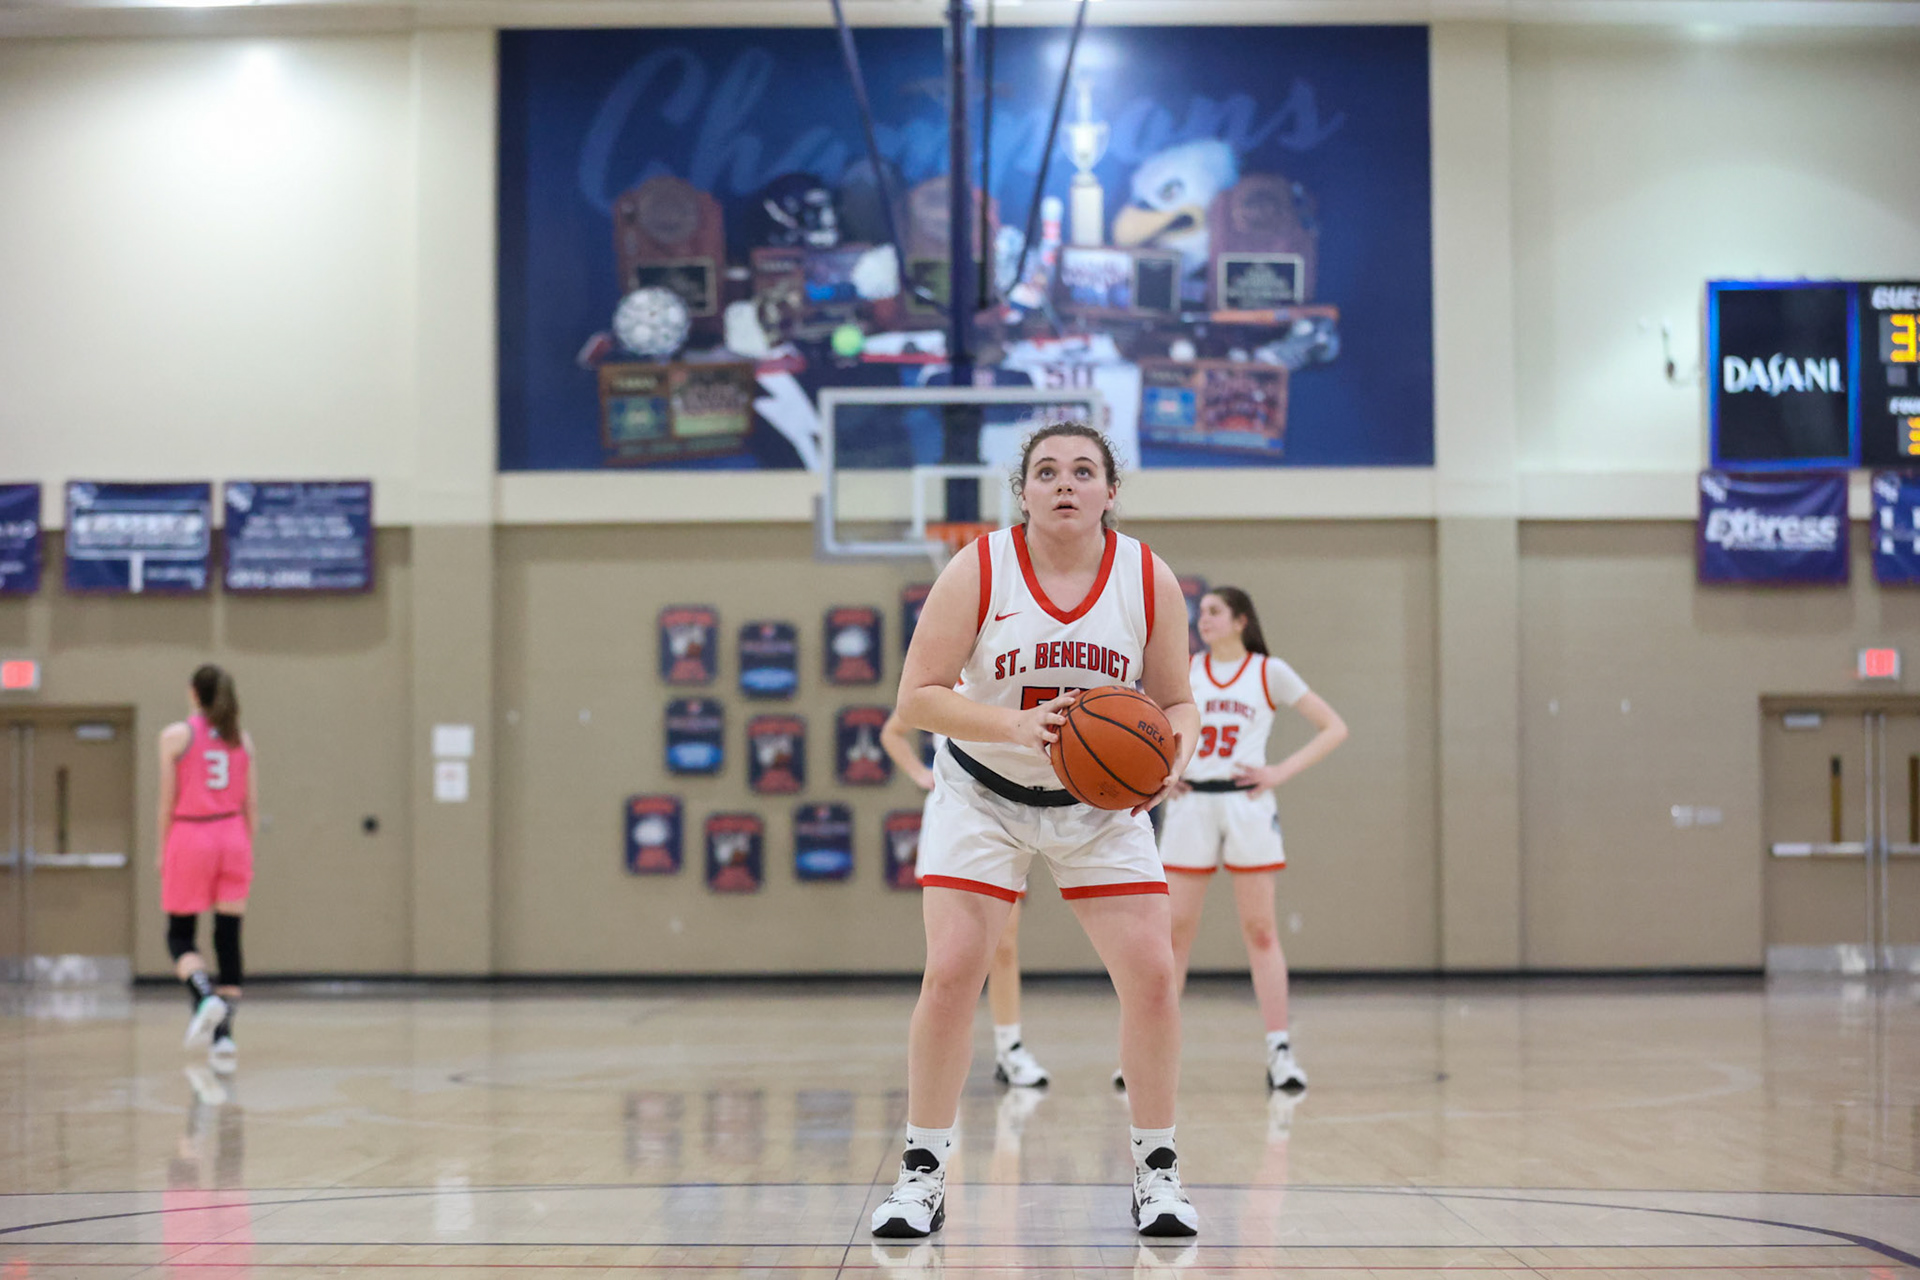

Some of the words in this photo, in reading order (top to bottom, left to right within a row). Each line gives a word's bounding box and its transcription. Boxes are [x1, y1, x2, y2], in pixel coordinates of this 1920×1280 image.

[1722, 353, 1841, 397] DASANI
[994, 648, 1027, 680] ST.
[1034, 641, 1130, 682] BENEDICT
[1137, 720, 1165, 746] ROCK
[1198, 725, 1239, 758] 35
[203, 750, 229, 790] 3
